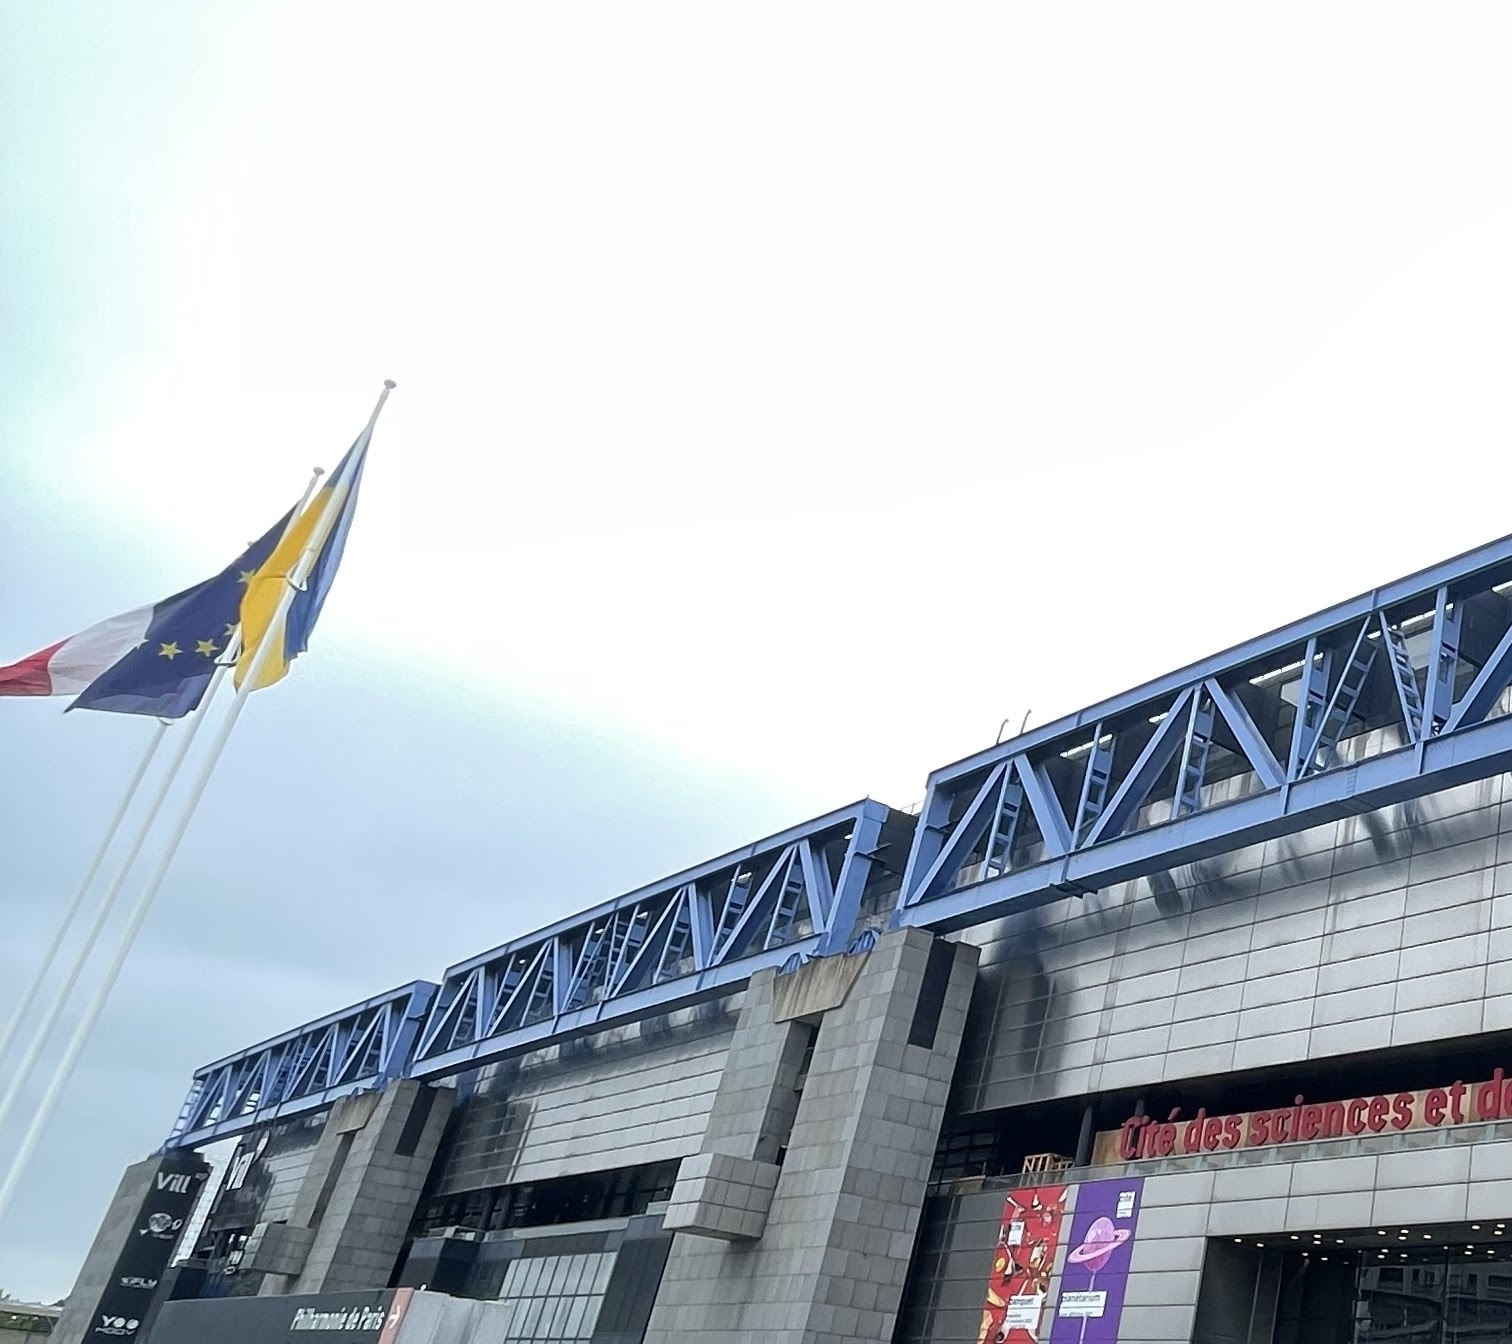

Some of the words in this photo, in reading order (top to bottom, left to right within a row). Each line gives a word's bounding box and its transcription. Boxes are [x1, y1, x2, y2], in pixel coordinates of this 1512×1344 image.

[1119, 1107, 1181, 1160] Cité
[1184, 1108, 1241, 1154] des
[1249, 1094, 1415, 1146] sciences
[1424, 1080, 1466, 1126] et
[157, 1172, 191, 1193] Vill
[290, 1307, 348, 1330] Philharmonie
[344, 1307, 360, 1330] de
[357, 1306, 385, 1330] Paris
